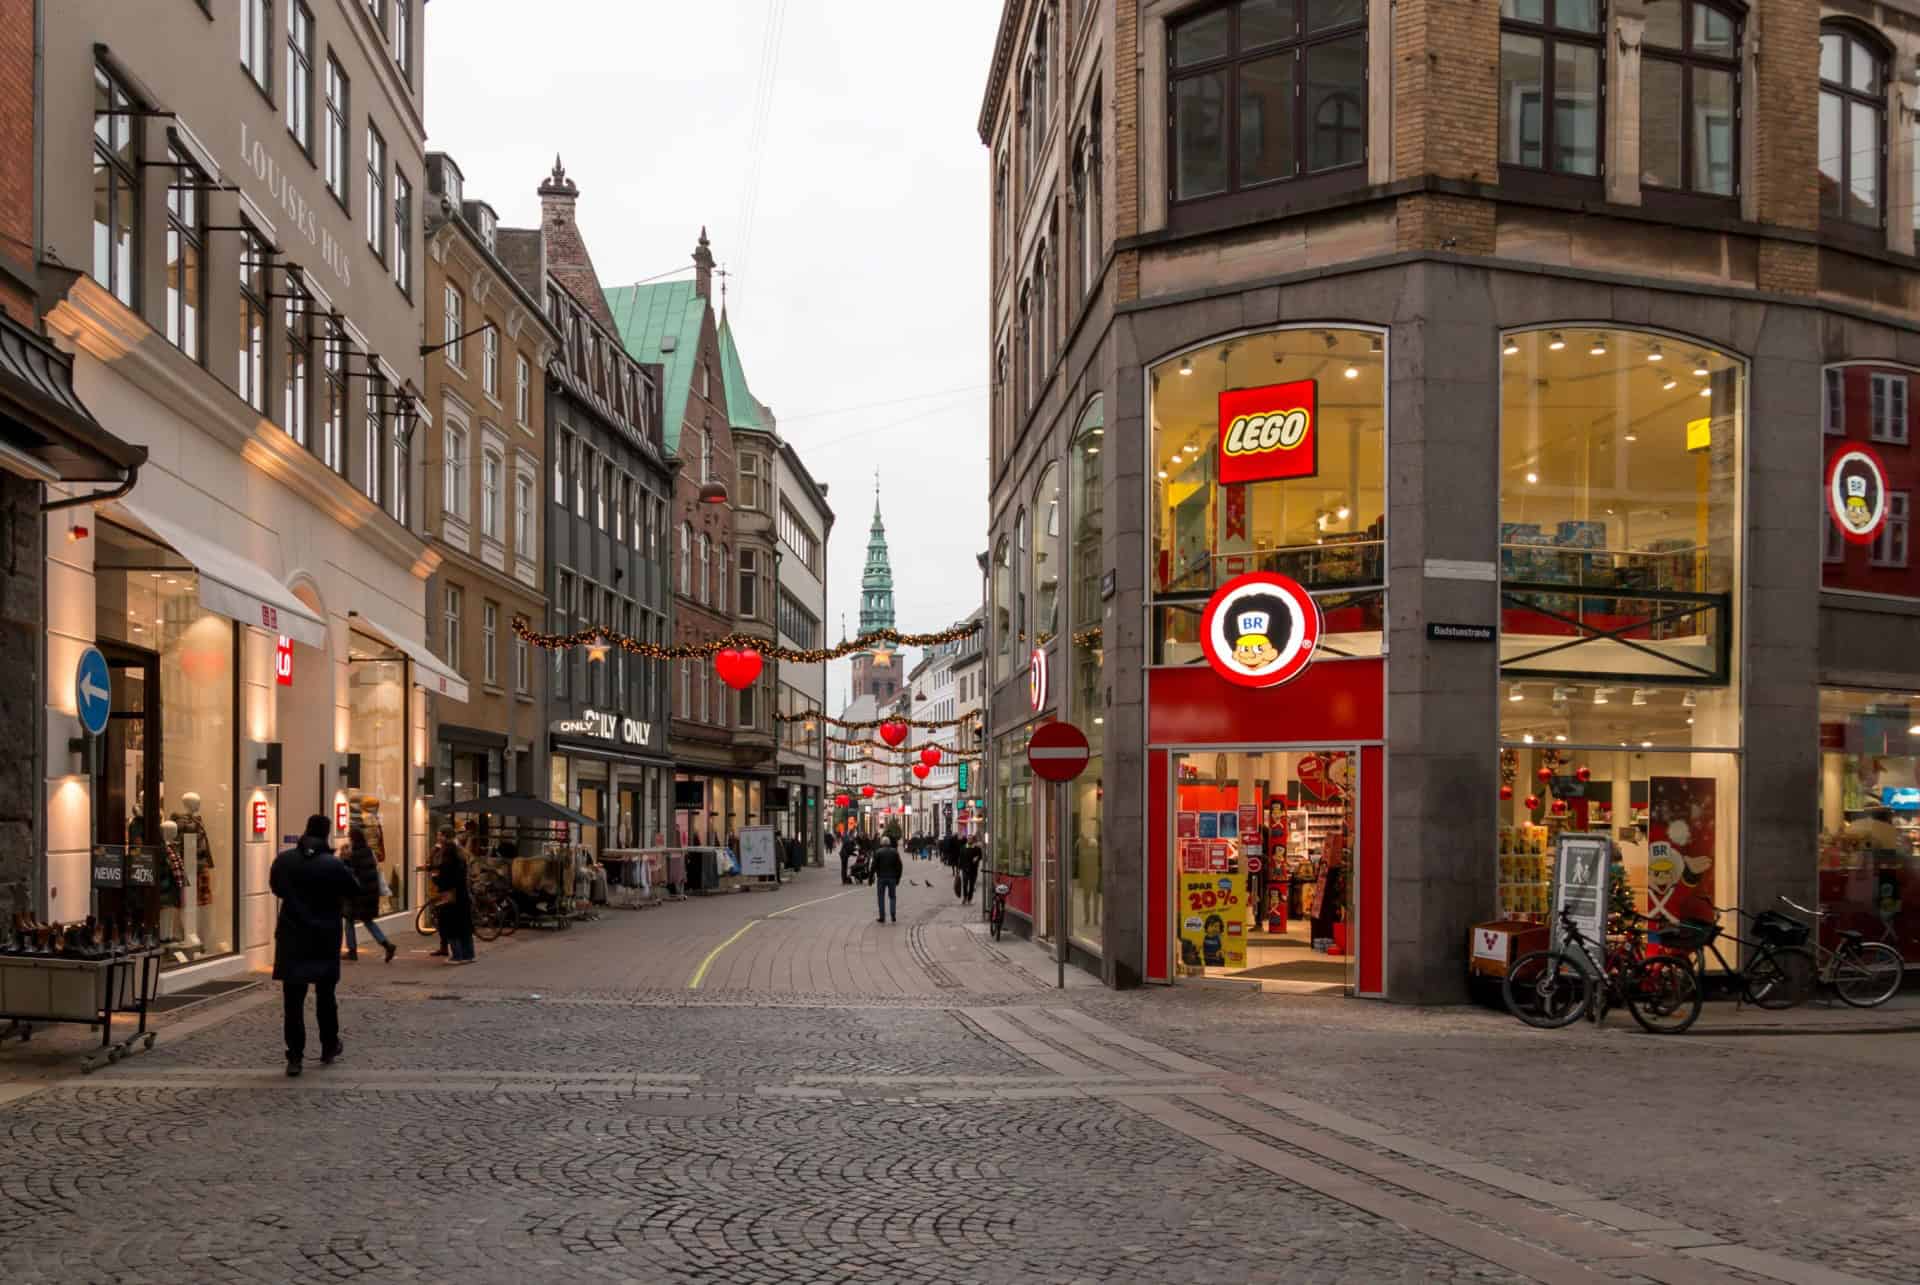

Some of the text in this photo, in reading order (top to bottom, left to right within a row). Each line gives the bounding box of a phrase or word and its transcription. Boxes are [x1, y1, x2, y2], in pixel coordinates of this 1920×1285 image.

[241, 121, 350, 289] LOUISES HUS
[1226, 410, 1307, 454] LEGO
[1243, 617, 1263, 629] BR
[560, 721, 593, 732] ONLY
[624, 718, 651, 745] ONLY
[1653, 844, 1668, 856] BR
[94, 866, 121, 880] NEWS
[1188, 890, 1238, 911] 20%
